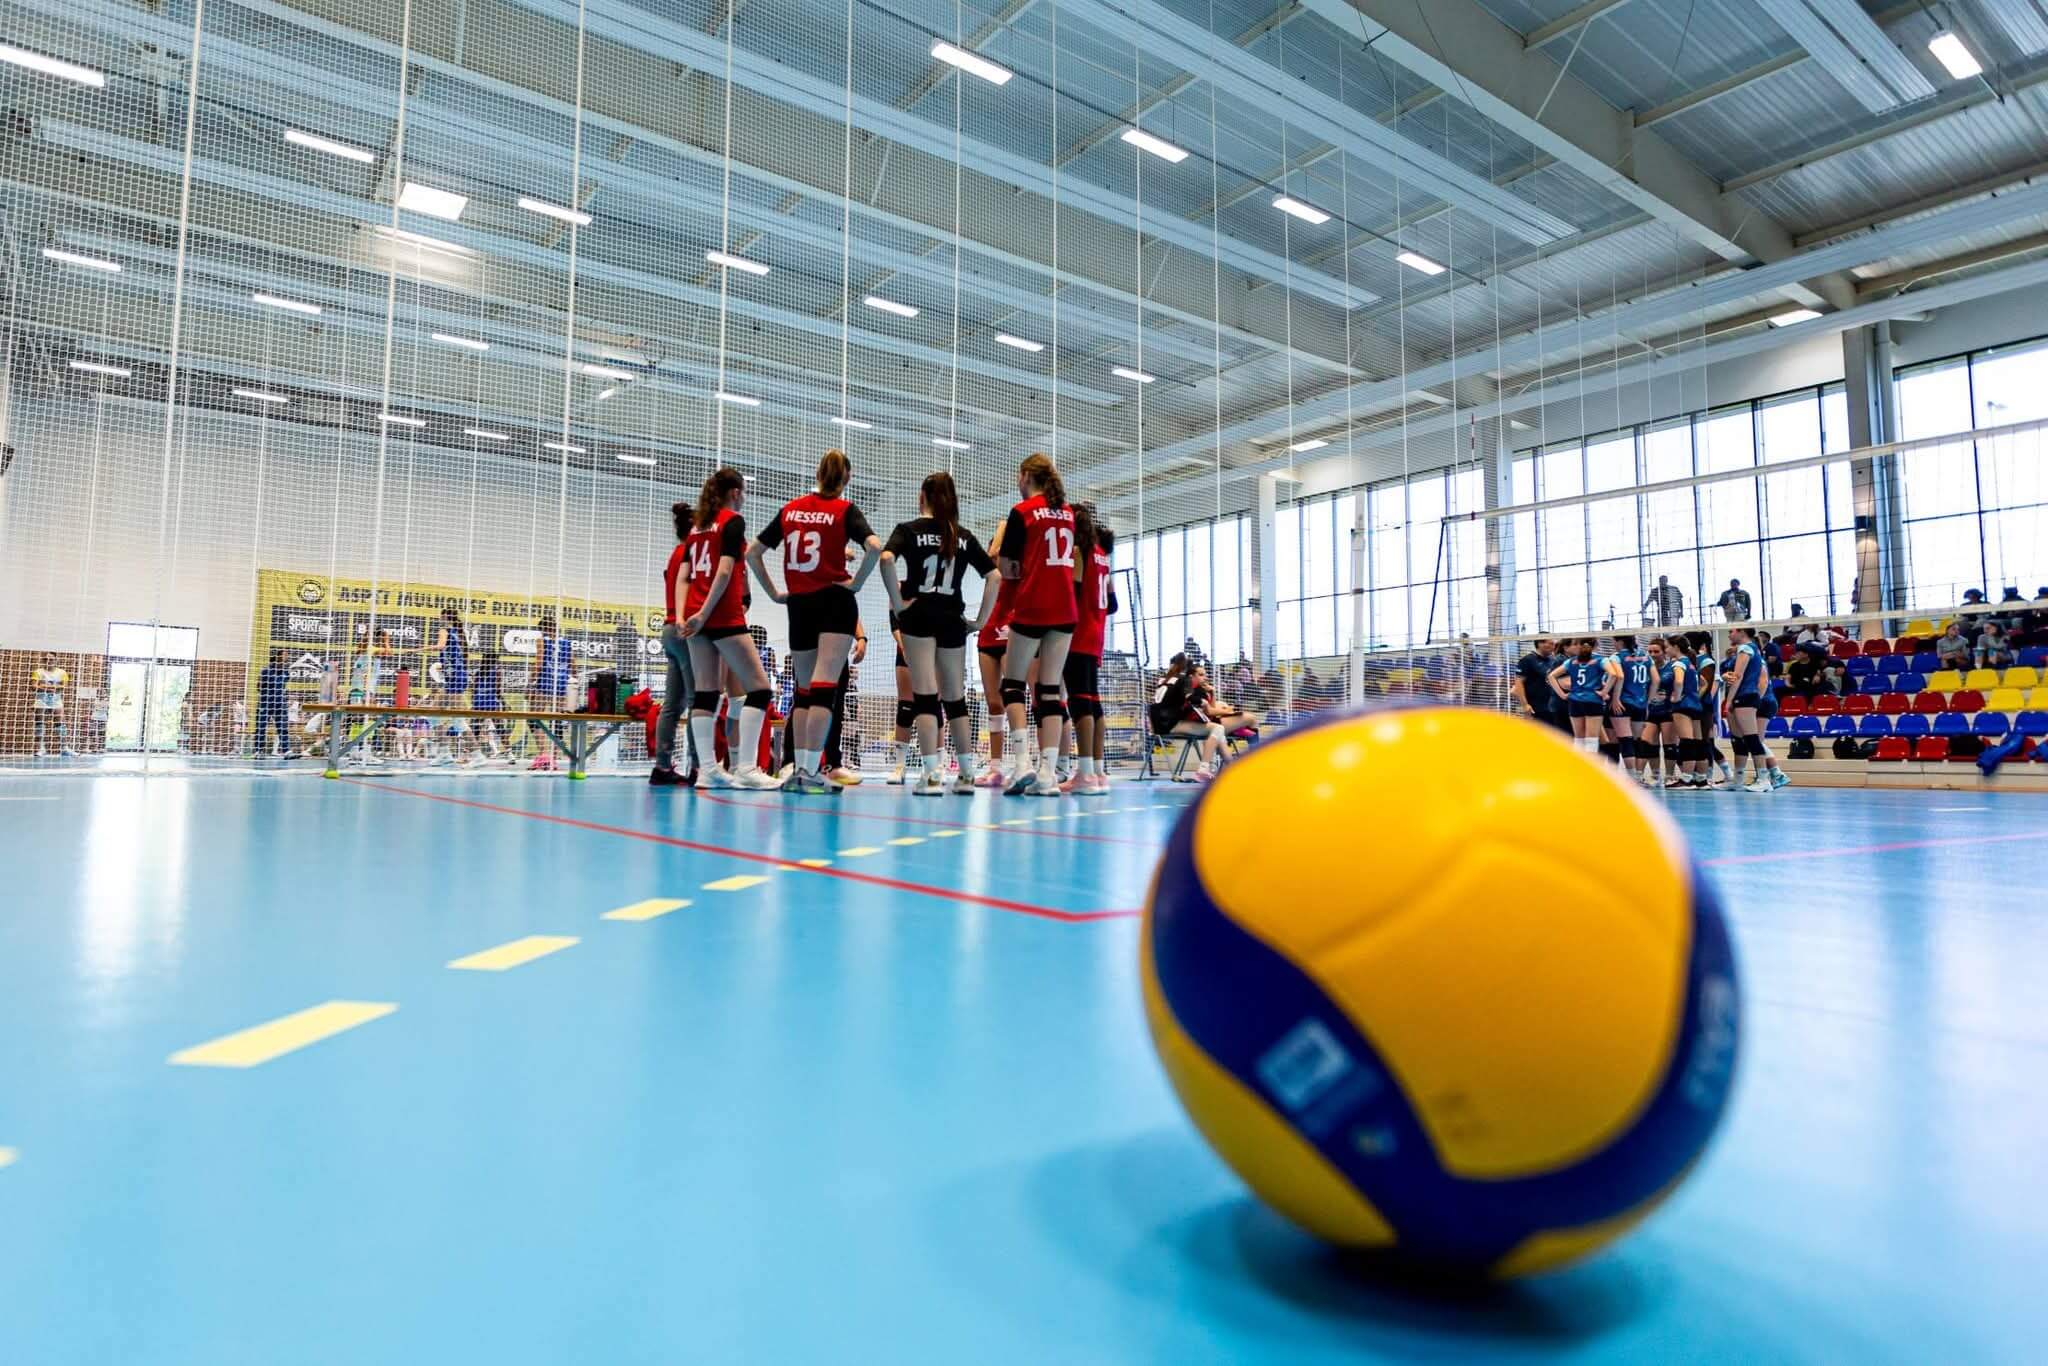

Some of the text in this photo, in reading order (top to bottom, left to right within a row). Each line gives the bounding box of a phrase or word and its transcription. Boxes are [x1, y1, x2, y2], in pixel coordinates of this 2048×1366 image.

[785, 510, 834, 525] HESSEN
[689, 539, 712, 579] 14
[786, 529, 821, 573] 13
[1044, 526, 1075, 568] 12
[918, 553, 956, 595] 11
[288, 616, 321, 632] SPORT
[397, 590, 487, 615] MULHOUSE
[492, 600, 557, 619] RIXHEIM
[562, 606, 637, 626] HANDBALL
[1576, 669, 1587, 686] 5
[1631, 664, 1648, 684] 10
